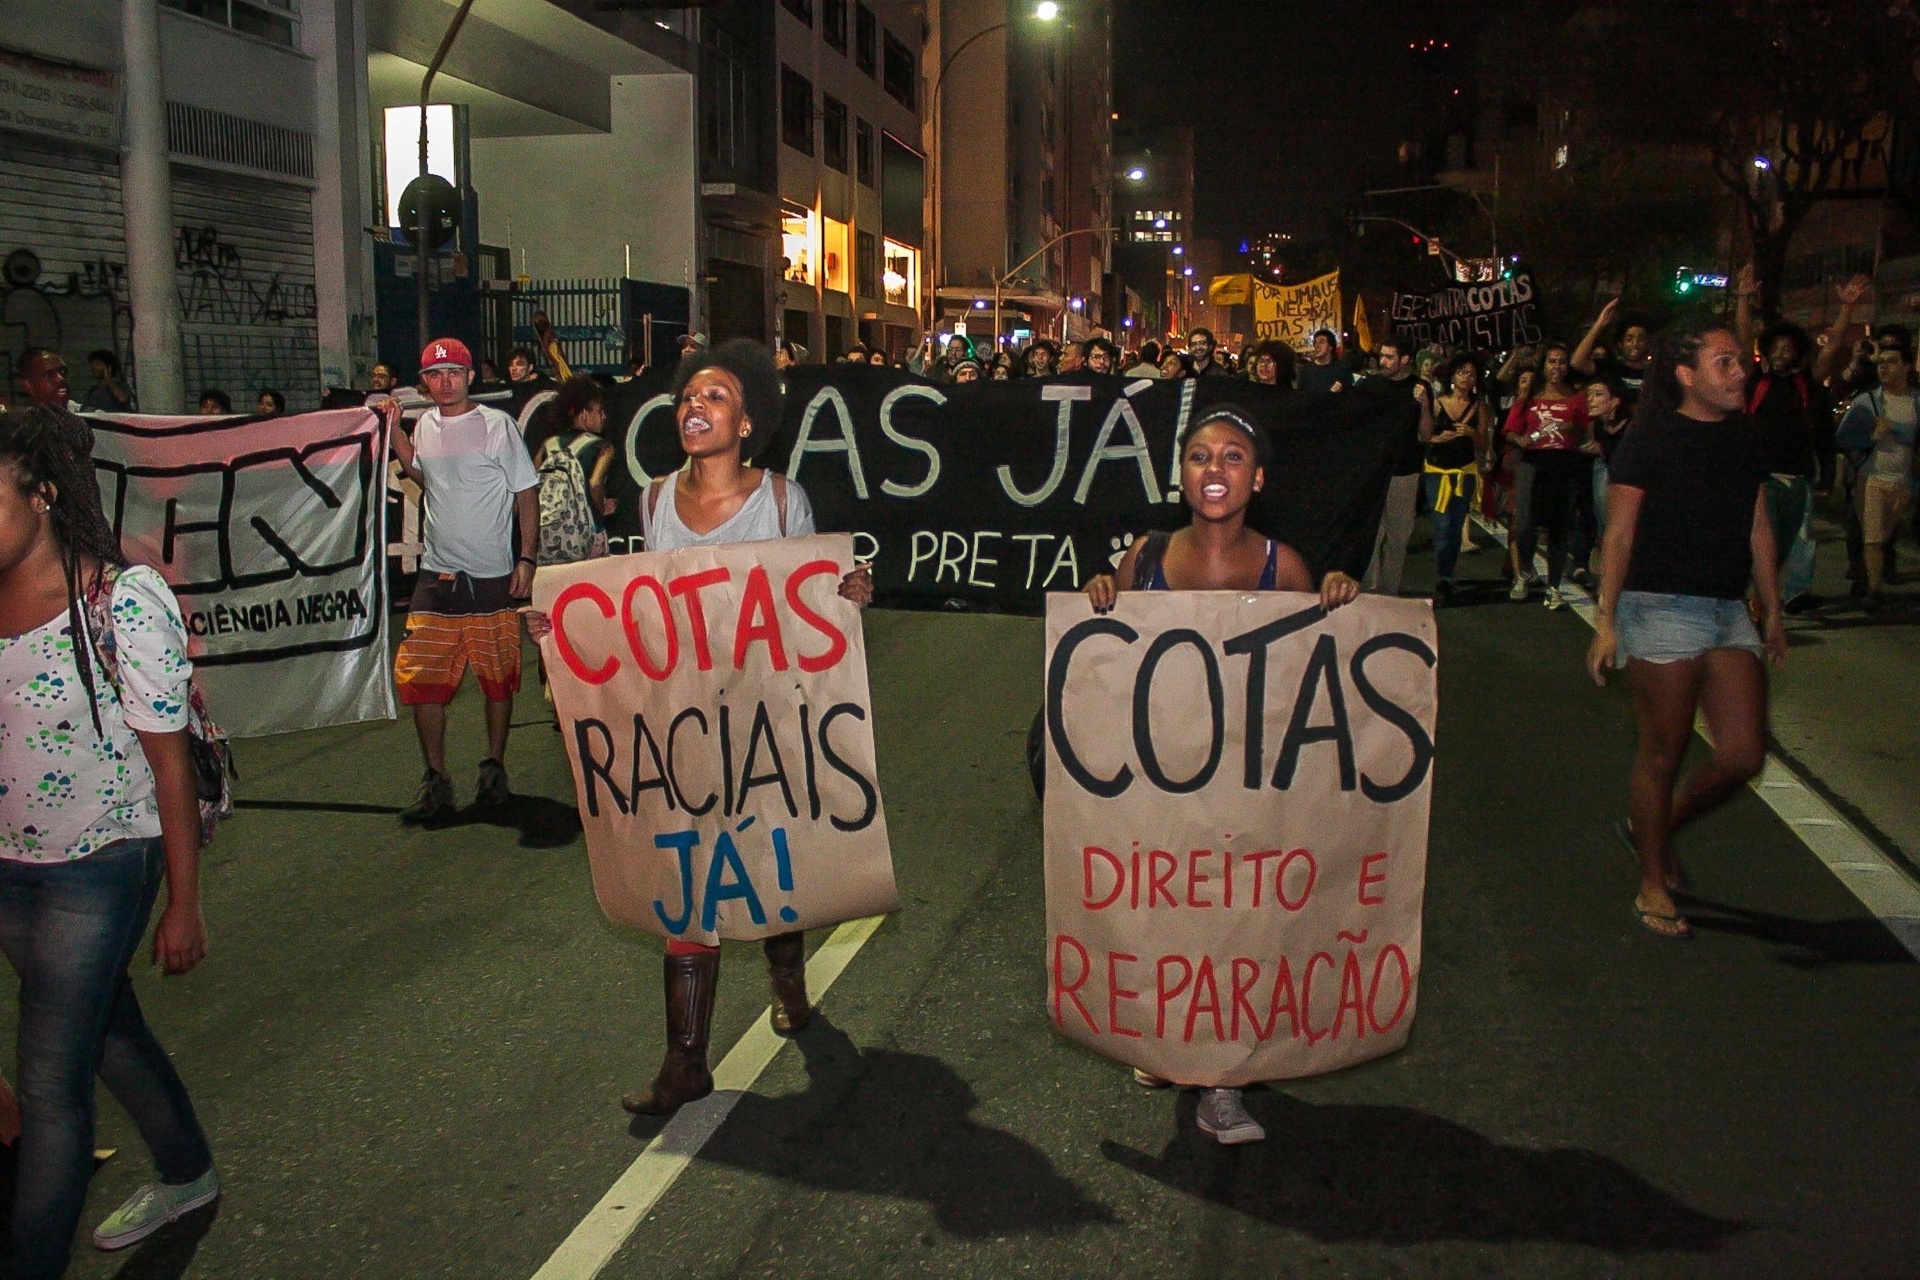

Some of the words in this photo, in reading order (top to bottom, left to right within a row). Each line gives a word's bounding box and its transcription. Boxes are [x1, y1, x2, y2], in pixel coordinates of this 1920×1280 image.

[1466, 273, 1534, 312] COTAS
[434, 344, 447, 359] LA
[295, 588, 367, 625] NEGRA
[907, 530, 1079, 590] PRETA
[551, 560, 848, 686] COTAS
[1047, 603, 1438, 804] COTAS
[574, 686, 877, 832] RACIAIS
[653, 815, 799, 936] JÁ!
[1082, 833, 1317, 912] DIREITO
[1358, 852, 1388, 906] E
[1053, 929, 1412, 1046] REPARAÇÃO
